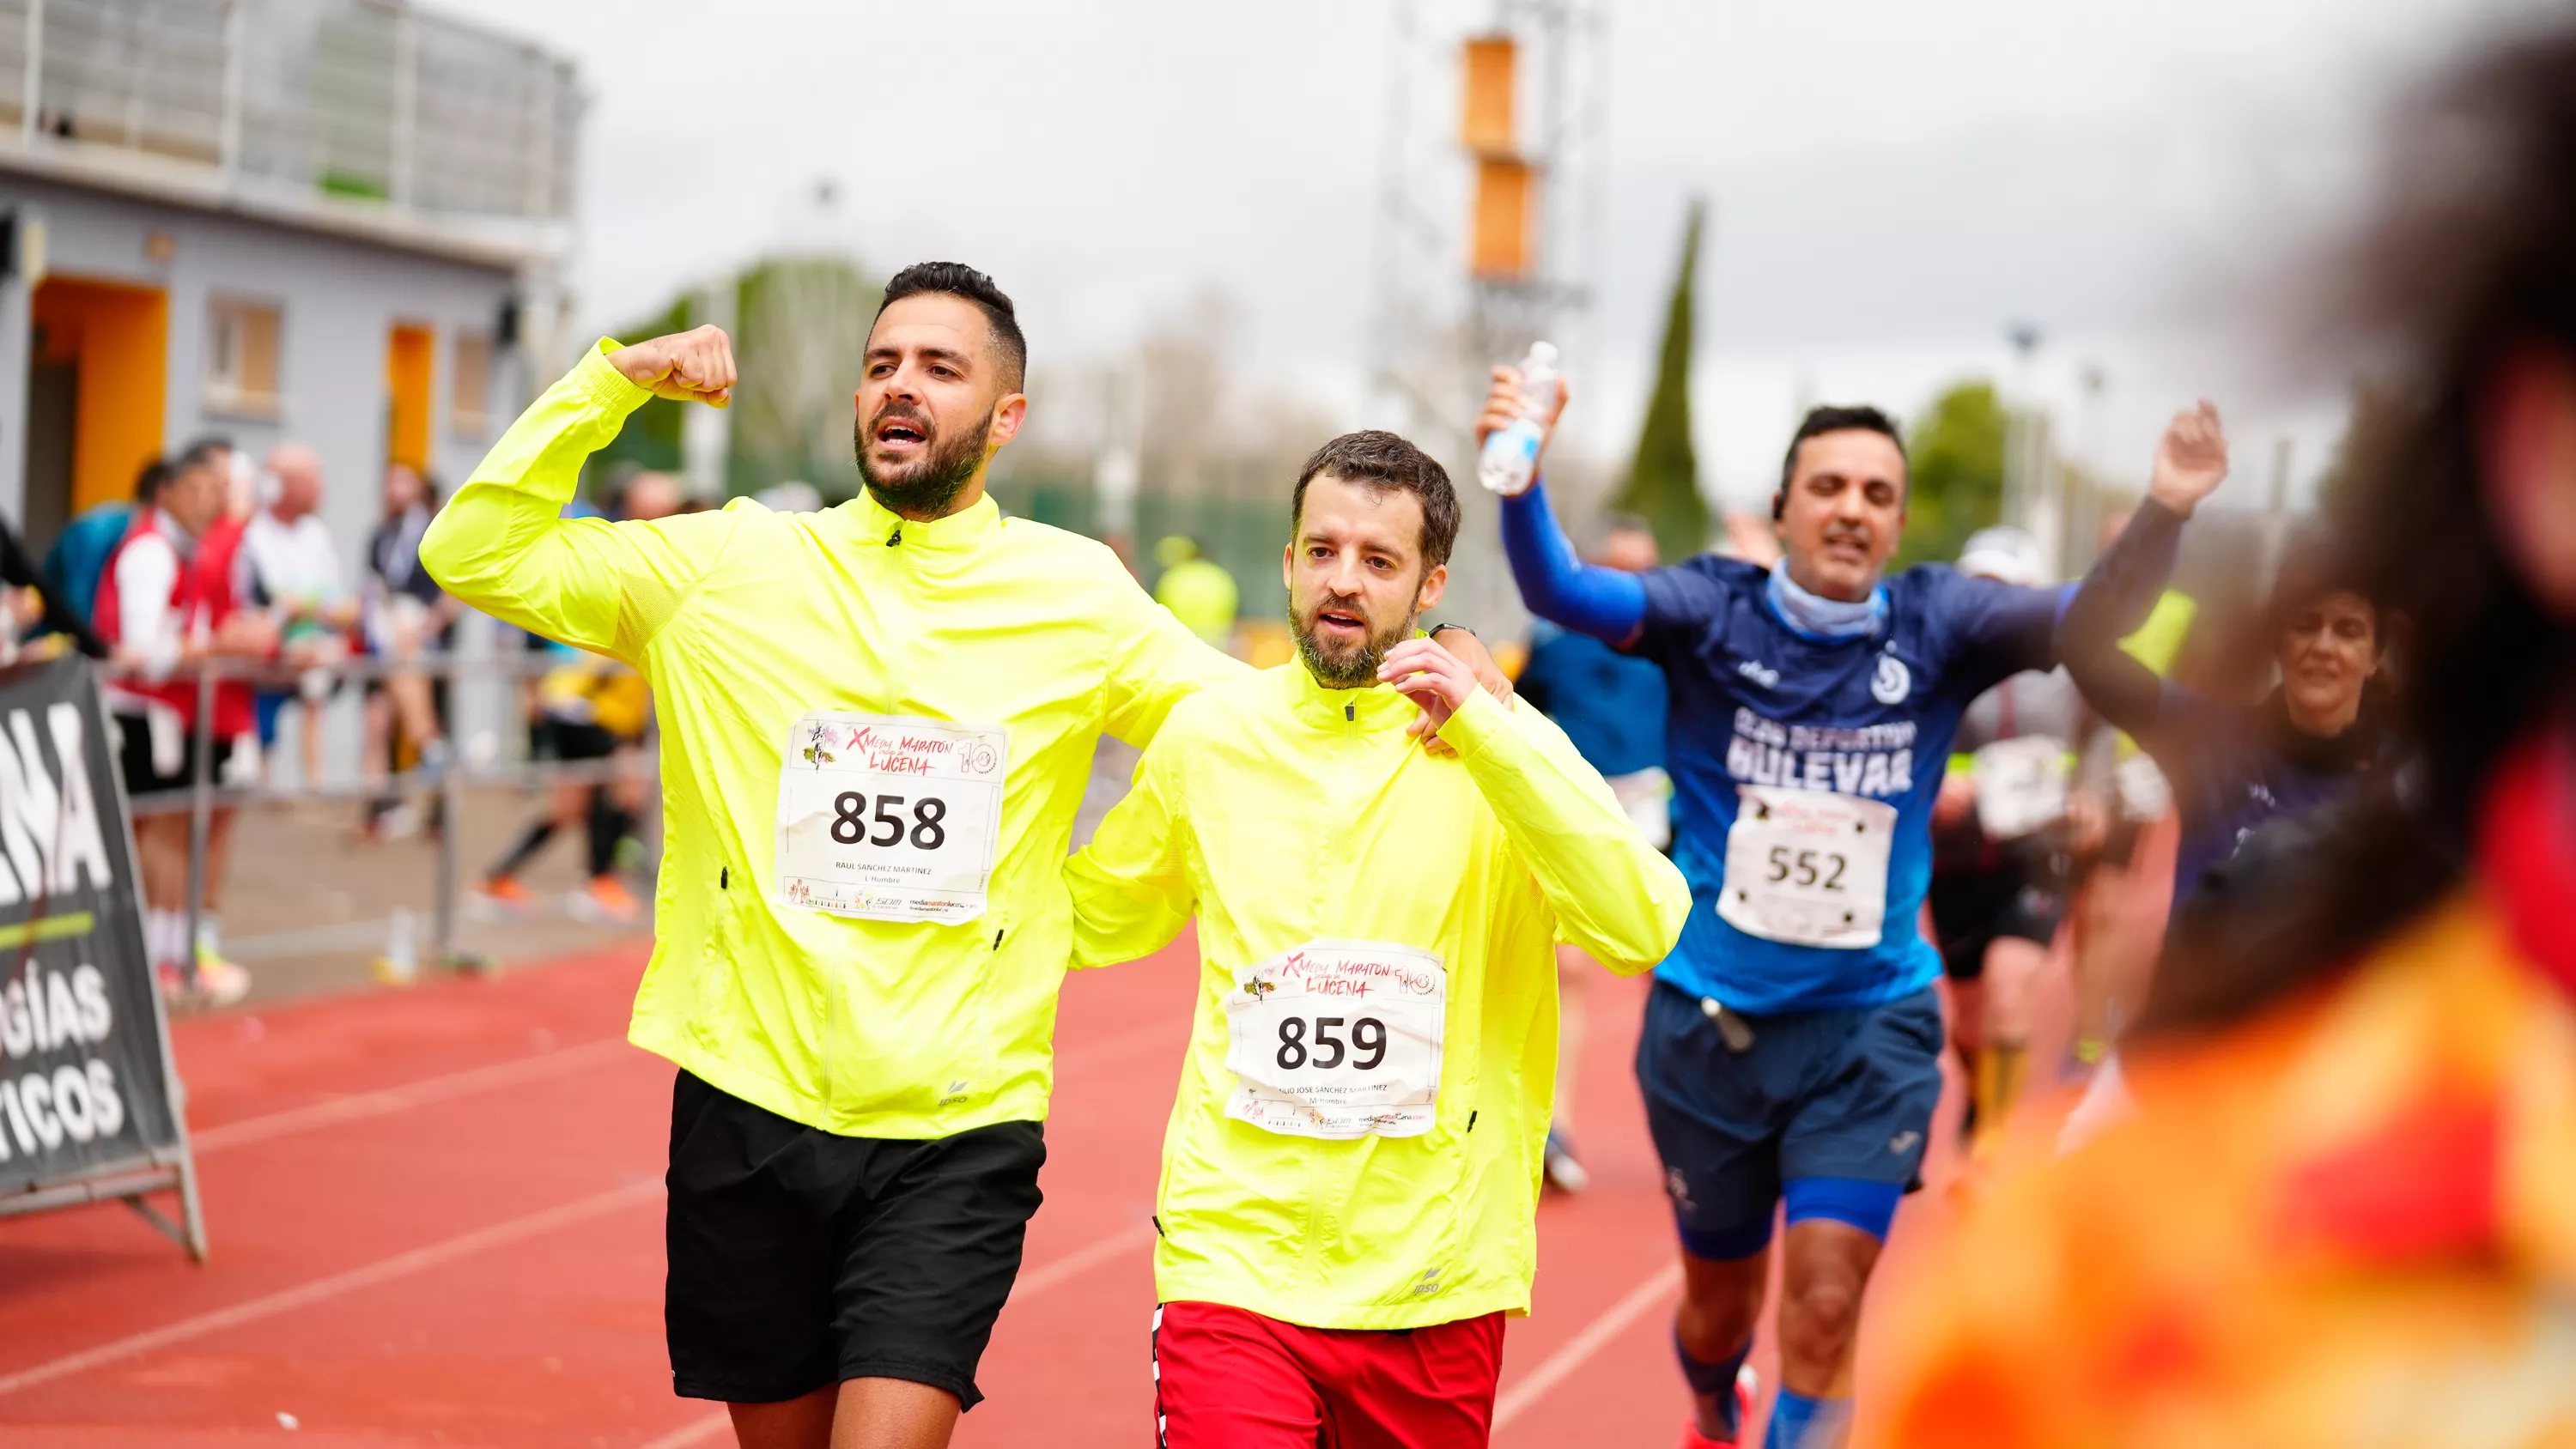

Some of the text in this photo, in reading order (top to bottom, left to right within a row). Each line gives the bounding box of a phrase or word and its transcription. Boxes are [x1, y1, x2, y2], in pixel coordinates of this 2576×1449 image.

[869, 751, 936, 777] LUCENA
[0, 701, 112, 906] NA
[830, 791, 946, 851] 858
[835, 861, 932, 876] RAUL SANCHEZ MARTINEZ
[865, 876, 901, 884] L-Hombre
[1767, 845, 1847, 892] 552
[1305, 975, 1374, 998] LUCENA
[0, 957, 112, 1058] GÍAS
[1276, 1016, 1387, 1070] 859
[1315, 1086, 1347, 1094] SANCHEZ
